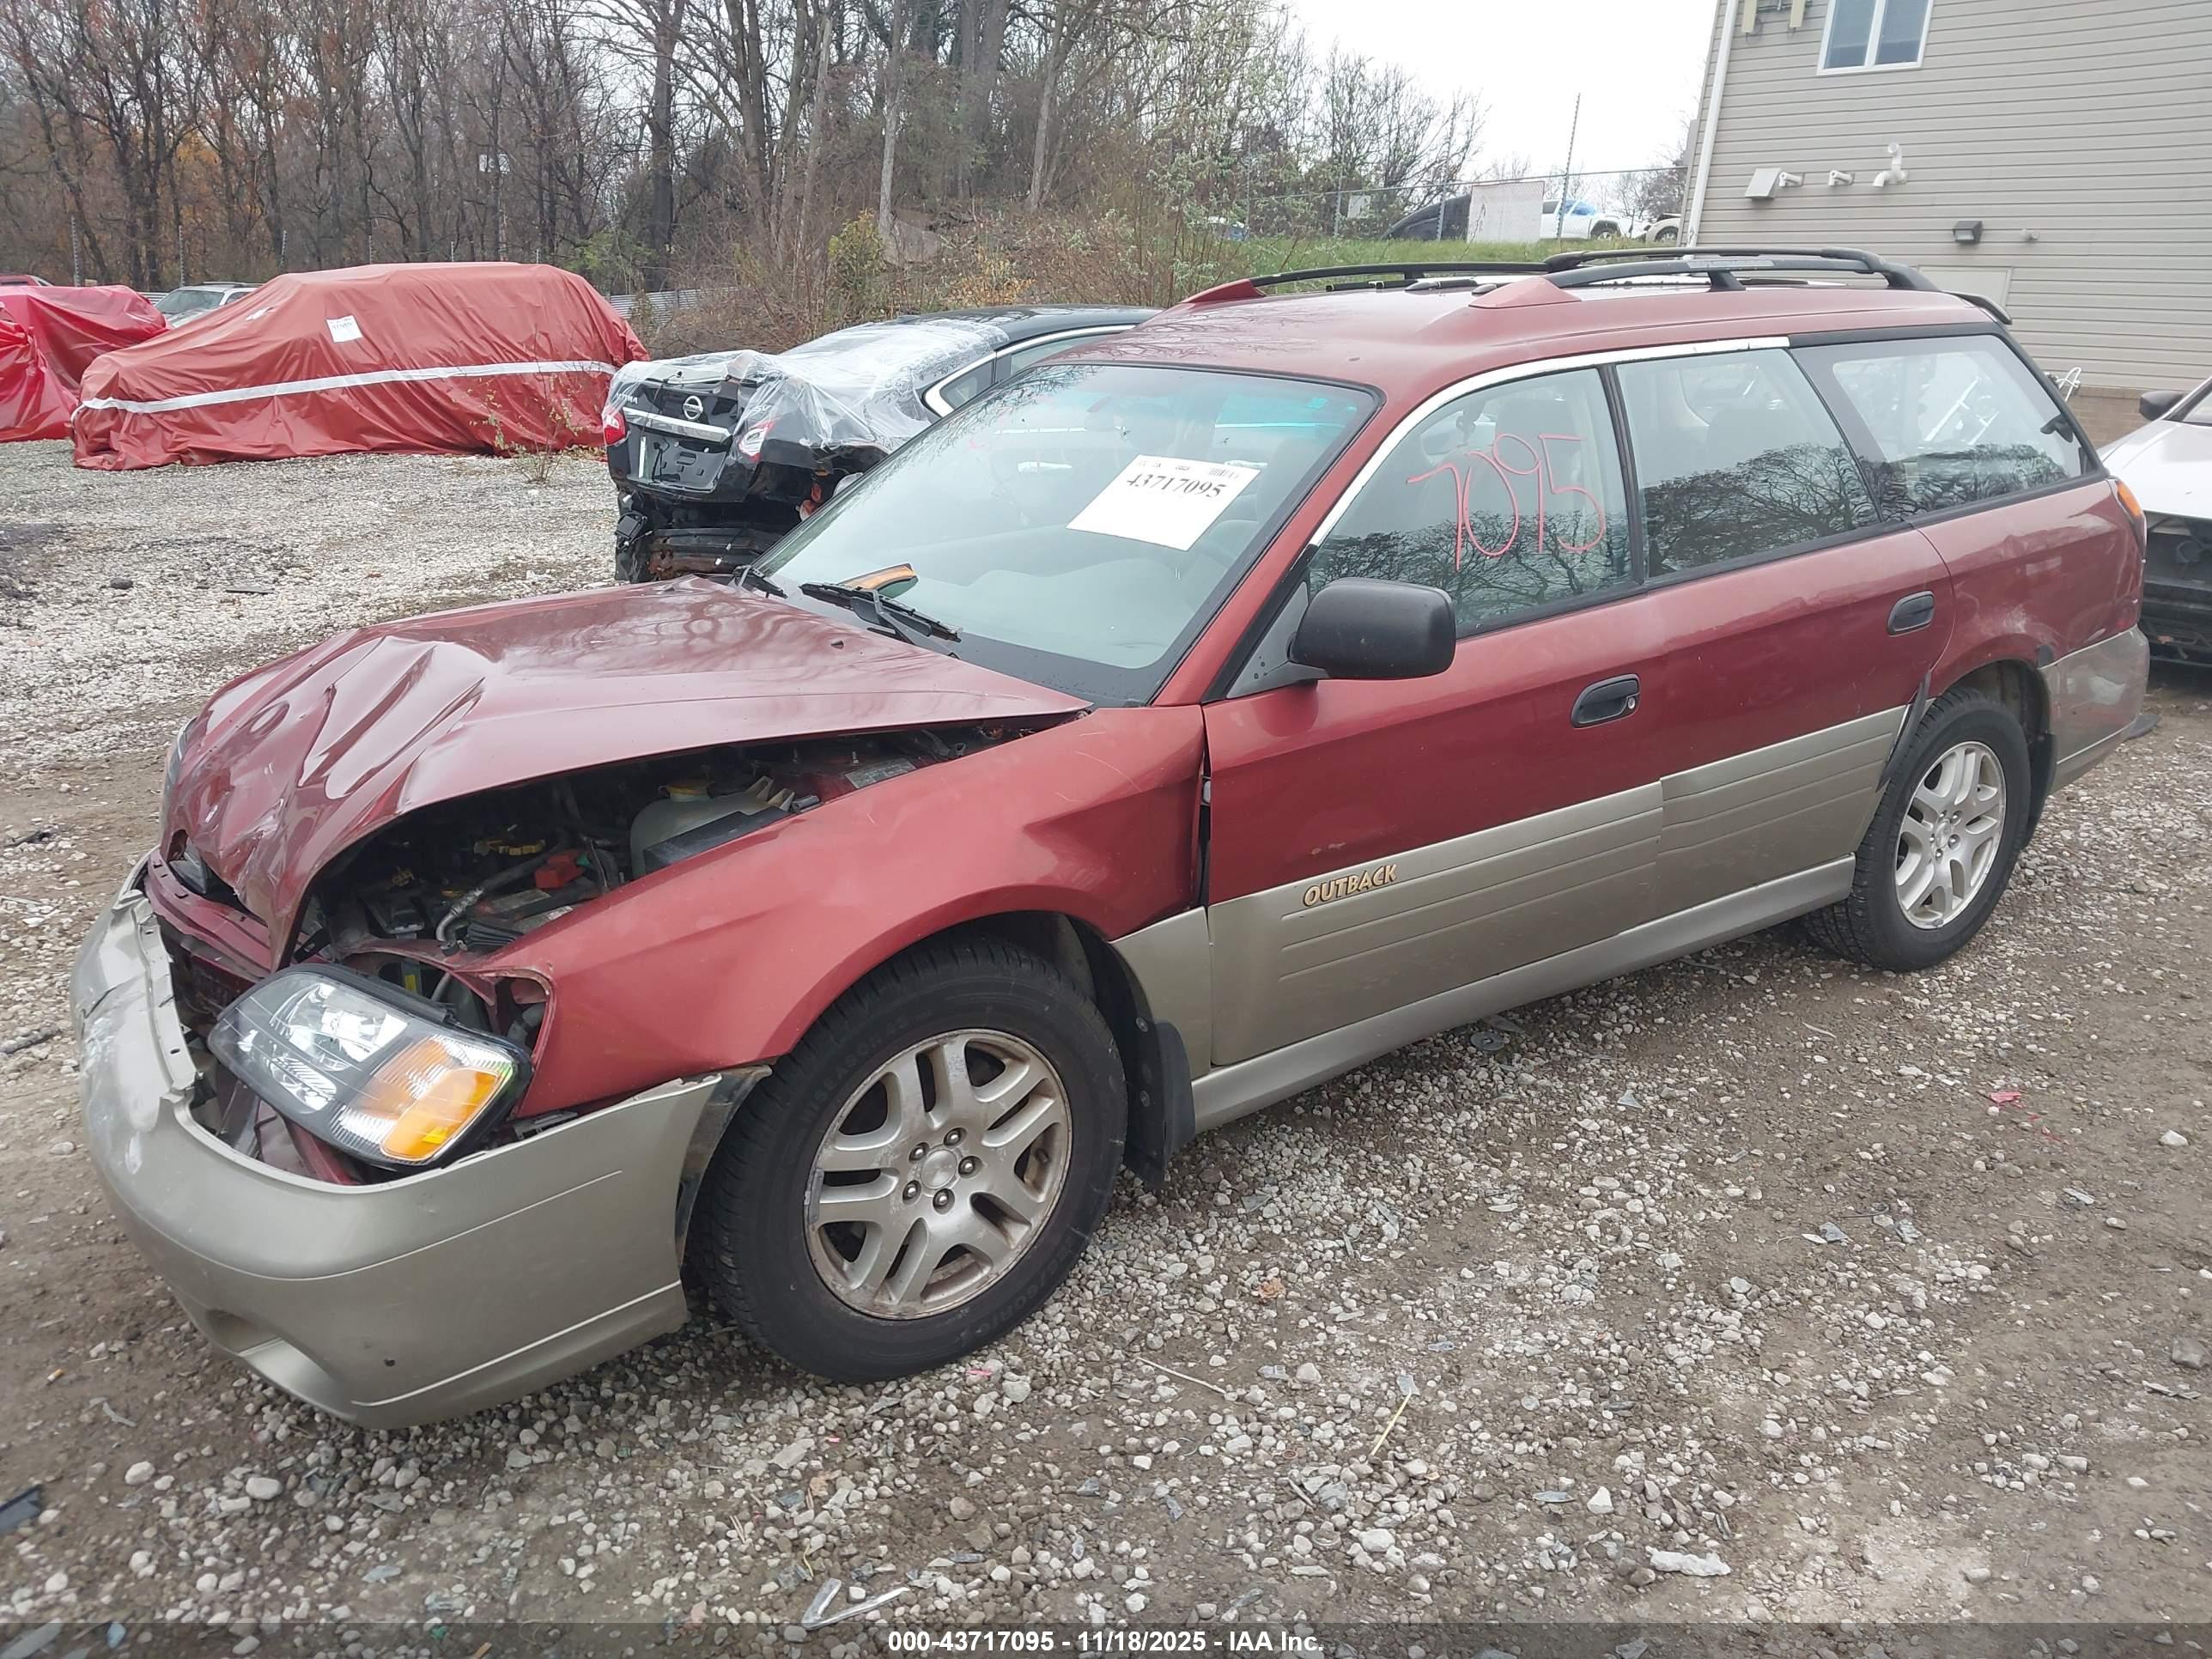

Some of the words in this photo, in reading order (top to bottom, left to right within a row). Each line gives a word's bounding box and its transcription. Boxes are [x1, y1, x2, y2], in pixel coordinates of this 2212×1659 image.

[1126, 472, 1227, 498] 43717095
[1406, 432, 1607, 573] 7095
[1303, 863, 1398, 907] OUTBACK
